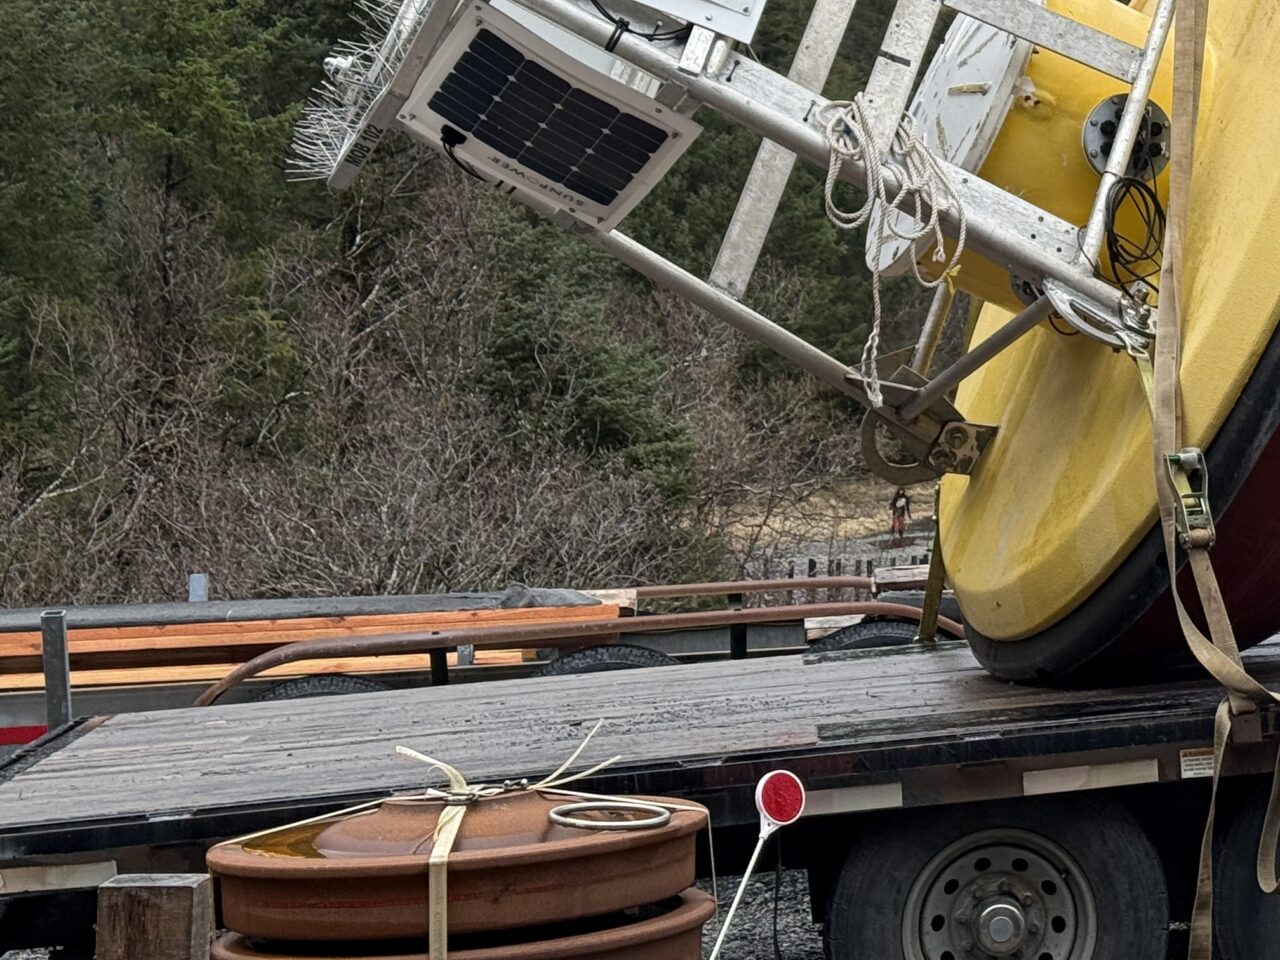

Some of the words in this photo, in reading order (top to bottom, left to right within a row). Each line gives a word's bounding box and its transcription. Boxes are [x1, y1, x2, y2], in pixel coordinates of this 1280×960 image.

[345, 142, 371, 167] MOB
[360, 124, 384, 144] 102
[490, 155, 584, 207] SUNPOWER
